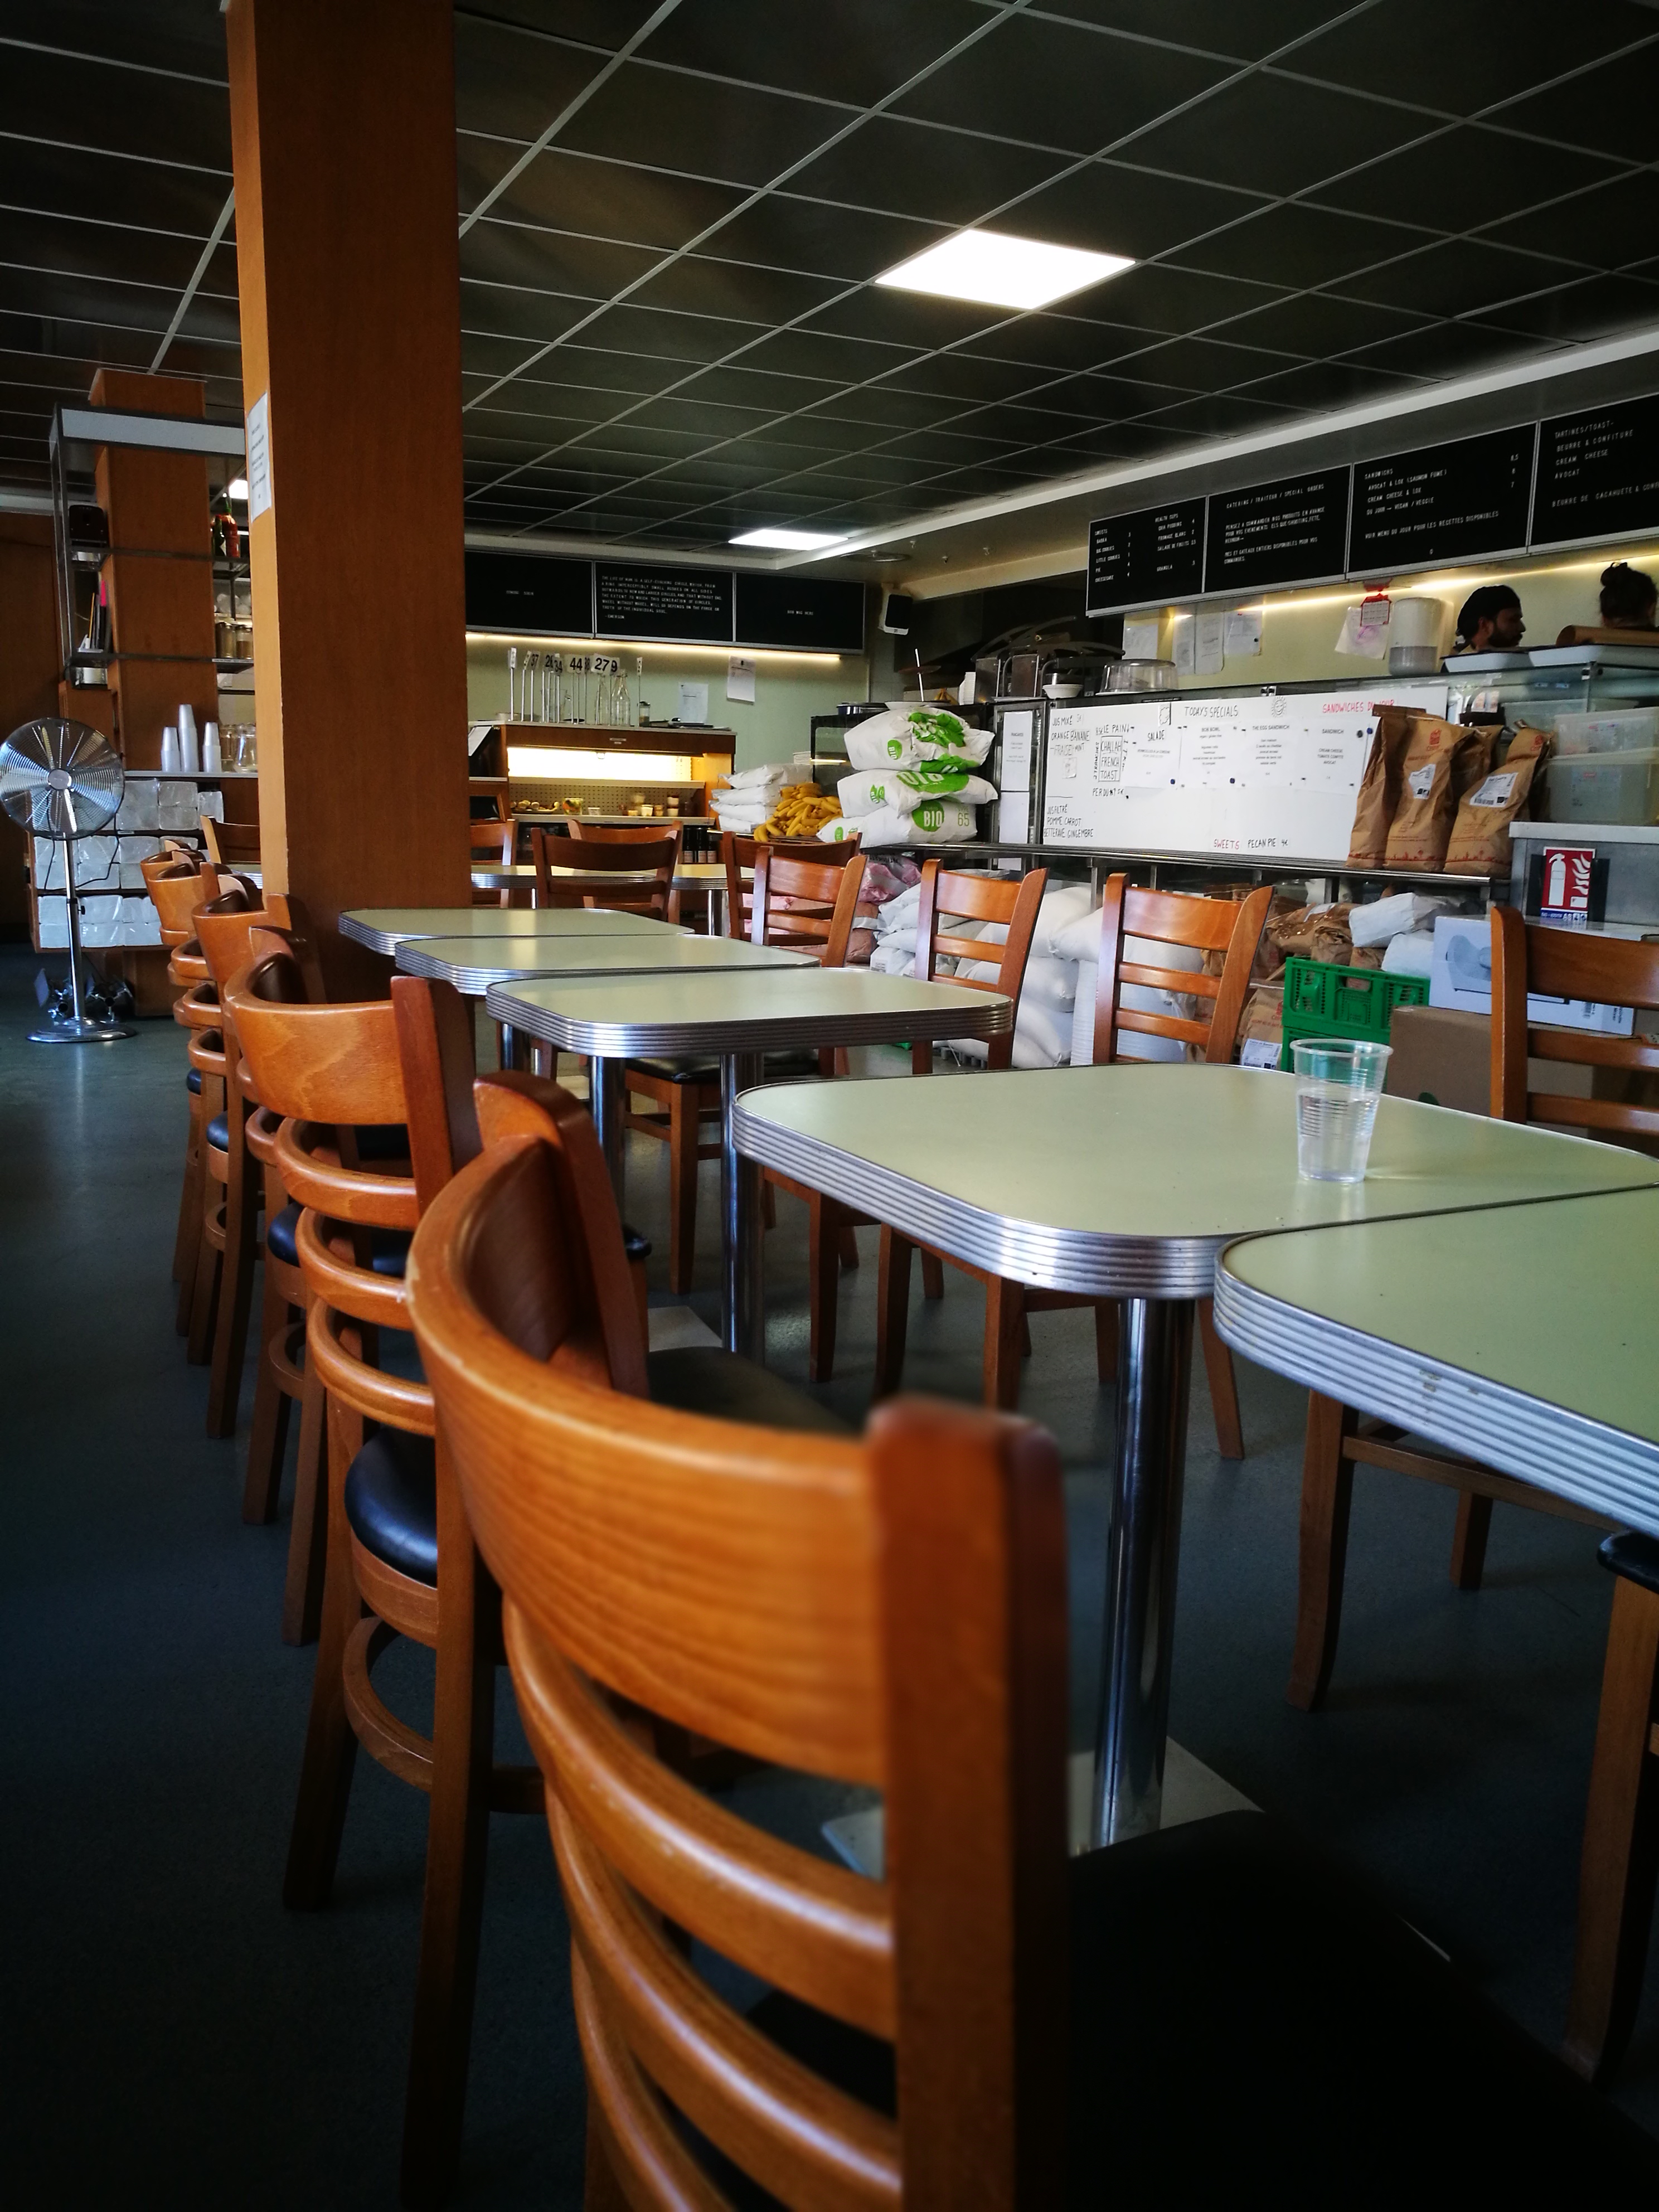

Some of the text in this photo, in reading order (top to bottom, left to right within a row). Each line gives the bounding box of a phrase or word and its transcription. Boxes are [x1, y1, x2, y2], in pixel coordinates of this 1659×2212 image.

[1556, 440, 1582, 452] BEURRE
[1593, 429, 1633, 444] CONFITURE
[1555, 449, 1609, 466] CREAM CHEESE
[1554, 468, 1580, 479] AVOCAT
[1368, 482, 1386, 491] AVOCAT
[1284, 488, 1303, 497] SPECIAL
[1367, 494, 1383, 503] CREAM
[1386, 490, 1403, 500] CHEESE
[1394, 502, 1409, 510] VEGAN
[1552, 496, 1578, 508] BEURRE
[1438, 517, 1463, 527] RECETTES
[570, 657, 583, 671] 44
[594, 658, 609, 671] 27
[1184, 705, 1239, 717] TODAY'S SPECIALS
[1322, 701, 1364, 713] SANDWICHES
[1051, 731, 1070, 741] ORANGE
[1070, 730, 1090, 741] BANANE
[1148, 730, 1165, 741] SALADE
[888, 746, 897, 759] BIO
[1102, 756, 1119, 767] FRENCH
[1100, 770, 1118, 780] TOAST
[924, 811, 943, 827] BIO
[958, 813, 969, 826] 65
[1068, 828, 1094, 838] GINGEMBRE
[1214, 839, 1239, 850] SWEETS
[1248, 838, 1267, 848] PECAN
[1268, 838, 1276, 847] PIE
